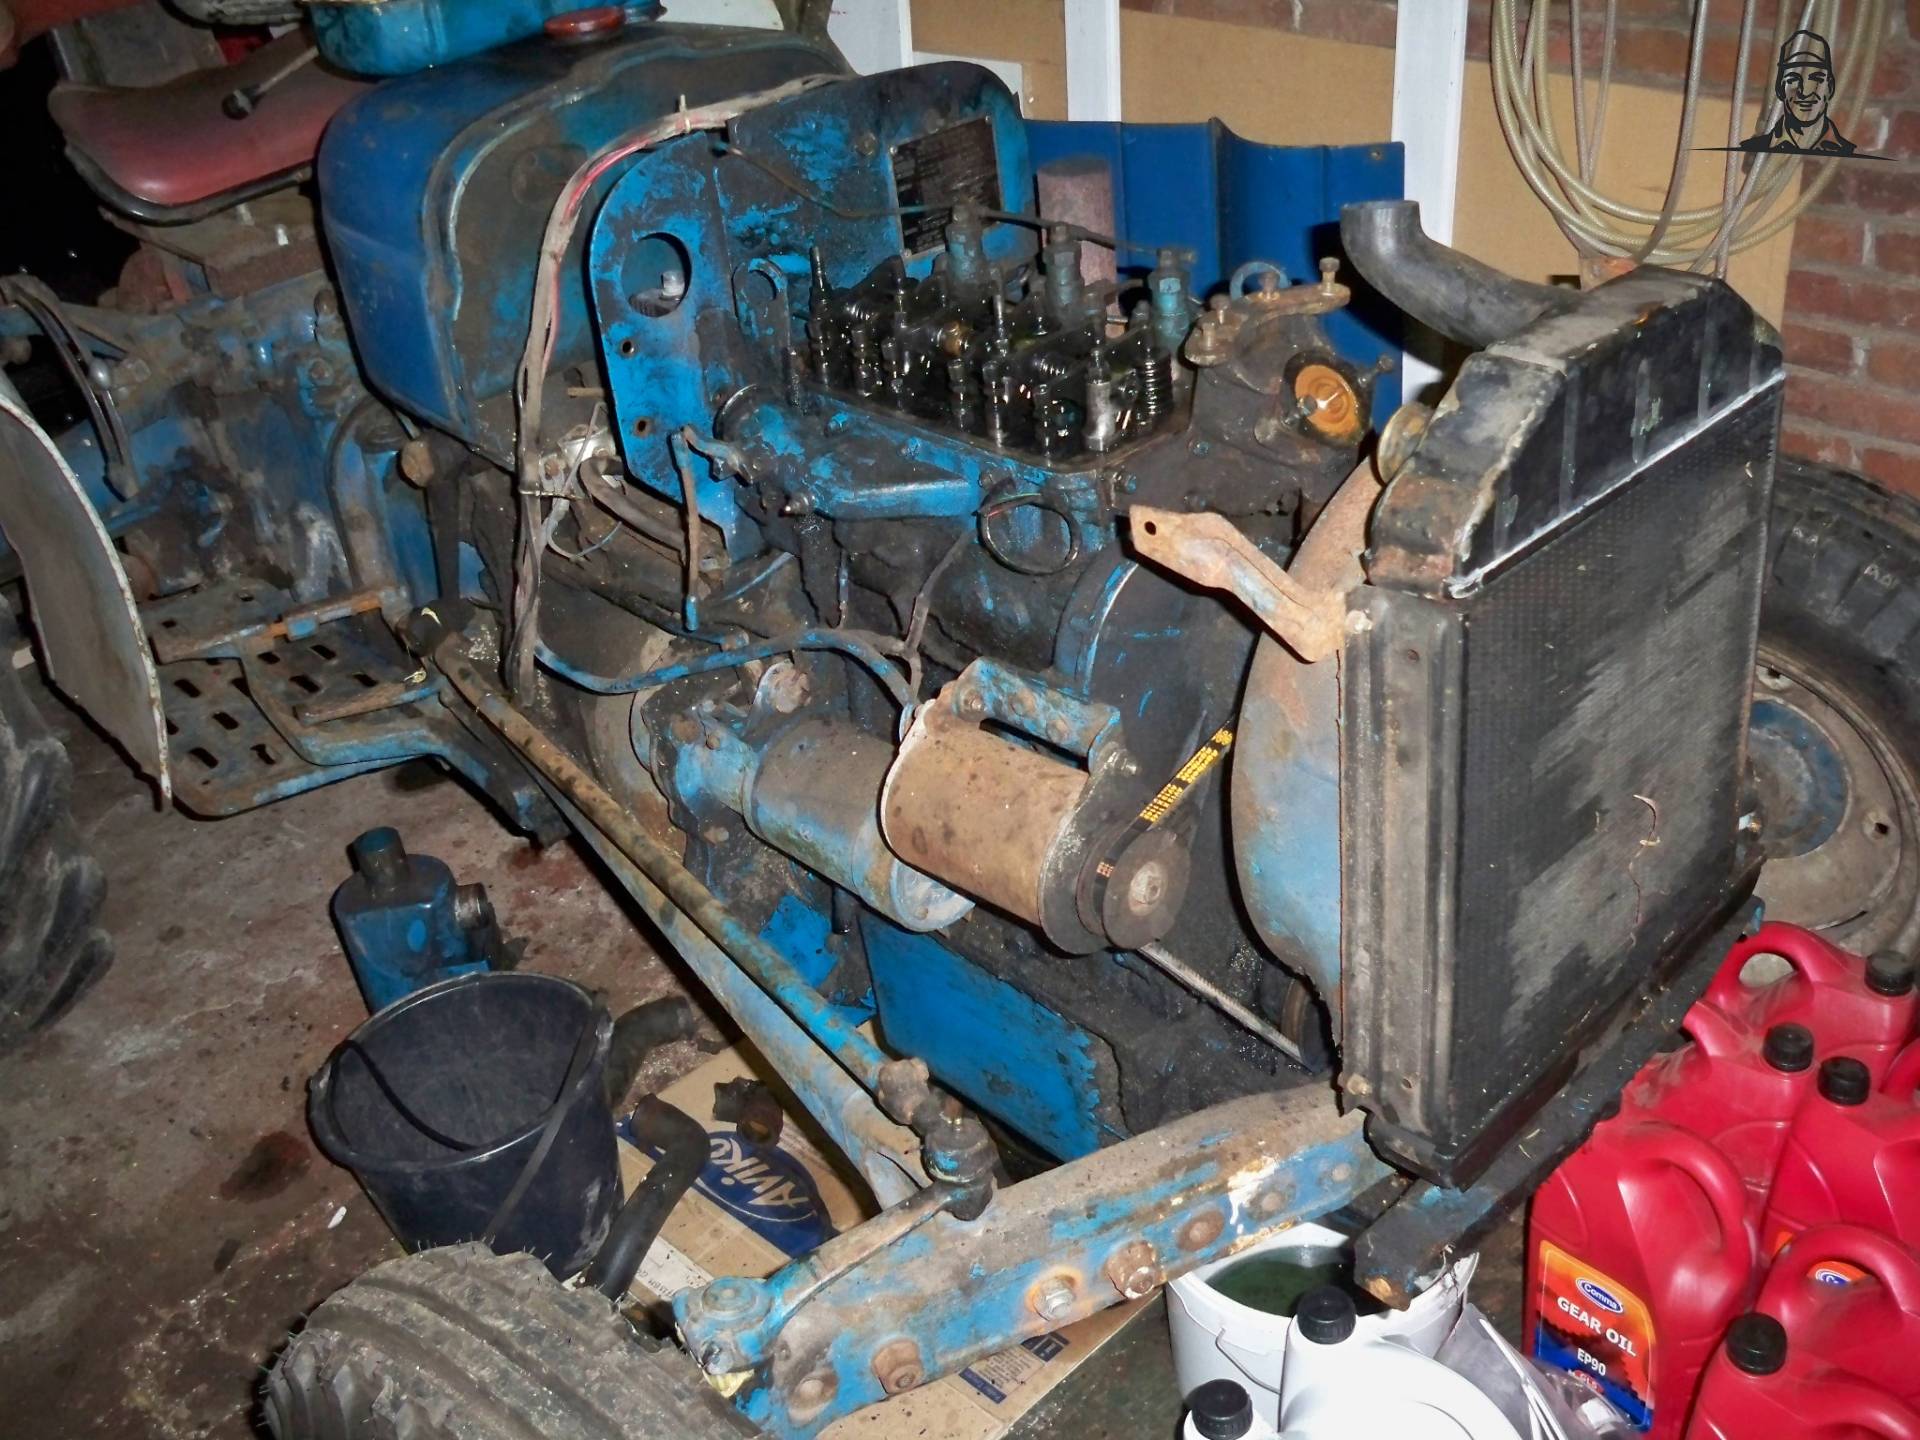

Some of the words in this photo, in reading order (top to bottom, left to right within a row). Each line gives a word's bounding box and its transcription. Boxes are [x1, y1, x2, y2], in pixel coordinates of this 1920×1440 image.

[1584, 1283, 1618, 1310] Comma
[1557, 1297, 1601, 1333] GEAR
[1605, 1328, 1636, 1357] OIL
[1577, 1348, 1606, 1376] EP90
